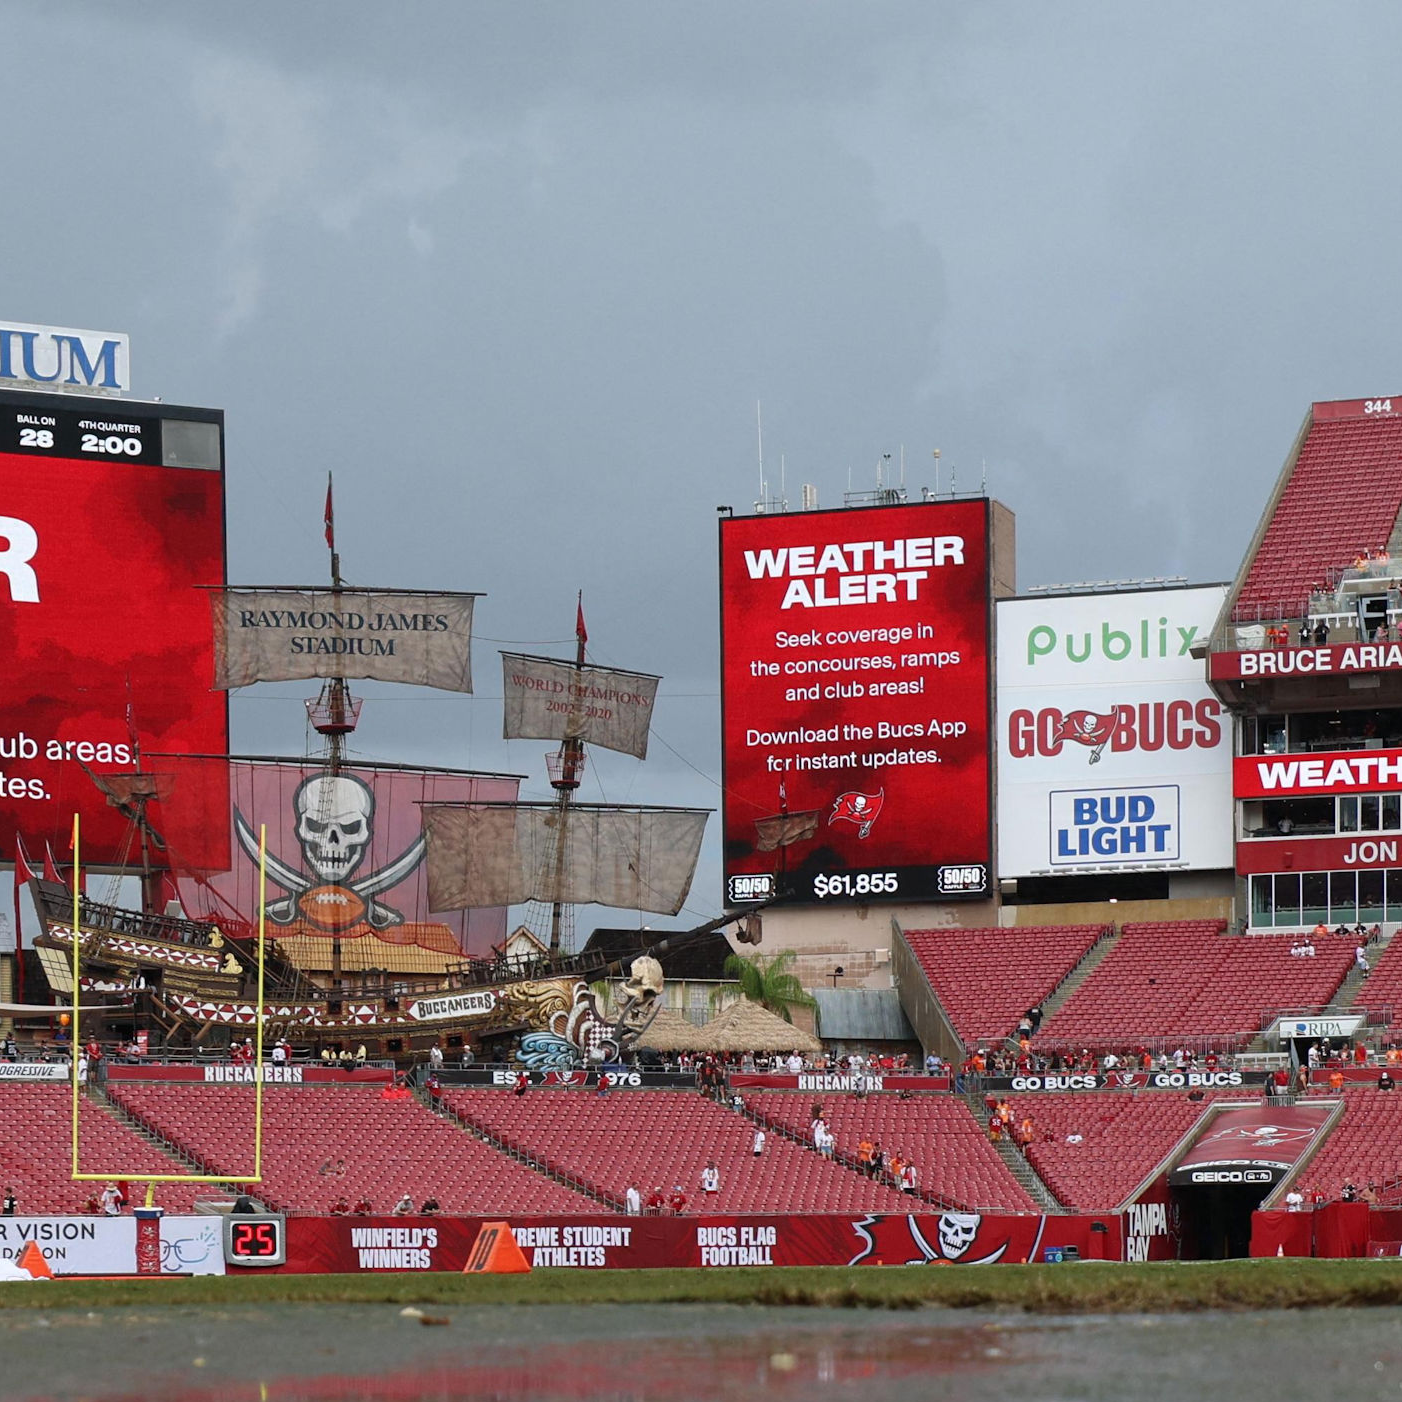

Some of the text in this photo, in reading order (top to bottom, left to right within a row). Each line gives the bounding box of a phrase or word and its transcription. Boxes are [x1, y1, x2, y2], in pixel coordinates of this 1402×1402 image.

[1364, 399, 1392, 414] 344
[16, 414, 56, 427] BALL ON
[97, 422, 141, 434] QUARTER
[19, 428, 54, 448] 28
[81, 433, 142, 456] 2:00
[744, 536, 965, 579] WEATHER
[780, 571, 928, 610] ALERT
[240, 610, 448, 632] RAYMOND JAMES
[290, 636, 396, 657] STADIUM
[775, 623, 934, 648] Seek coverage in
[1027, 616, 1198, 666] Publix
[750, 650, 961, 677] the concourses, ramps
[1239, 649, 1332, 676] BRUCE
[511, 675, 650, 707] WORLD CHAMPIONS
[785, 676, 925, 701] and club areas!
[546, 700, 612, 720] 2002 2020
[746, 719, 967, 746] Download the Bucs App
[1008, 698, 1221, 758] GO BUCS
[46, 738, 137, 765] areas.
[767, 749, 942, 772] for instant updates.
[1073, 795, 1155, 826] BUD
[1057, 824, 1171, 857] LIGHT
[1343, 840, 1400, 865] JON
[734, 877, 770, 894] 50/50
[813, 872, 898, 898] $61,855
[943, 867, 980, 884] 50/50
[417, 992, 493, 1018] BUCCANEERS
[1308, 1022, 1344, 1037] RIPA
[1012, 1071, 1243, 1091] GO BUCS GO BUCS
[1192, 1171, 1243, 1182] GEICO
[1127, 1203, 1167, 1236] TAMPA
[17, 1222, 95, 1241] VISION
[236, 1225, 273, 1254] 25
[351, 1227, 438, 1248] WINFIELD'S
[563, 1227, 631, 1247] STUDENT
[697, 1227, 777, 1247] BUCS FLAG
[359, 1248, 431, 1269] WINNERS
[533, 1248, 606, 1267] ATHLETES
[701, 1246, 773, 1266] FOOTBALL
[1127, 1236, 1150, 1262] BAY
